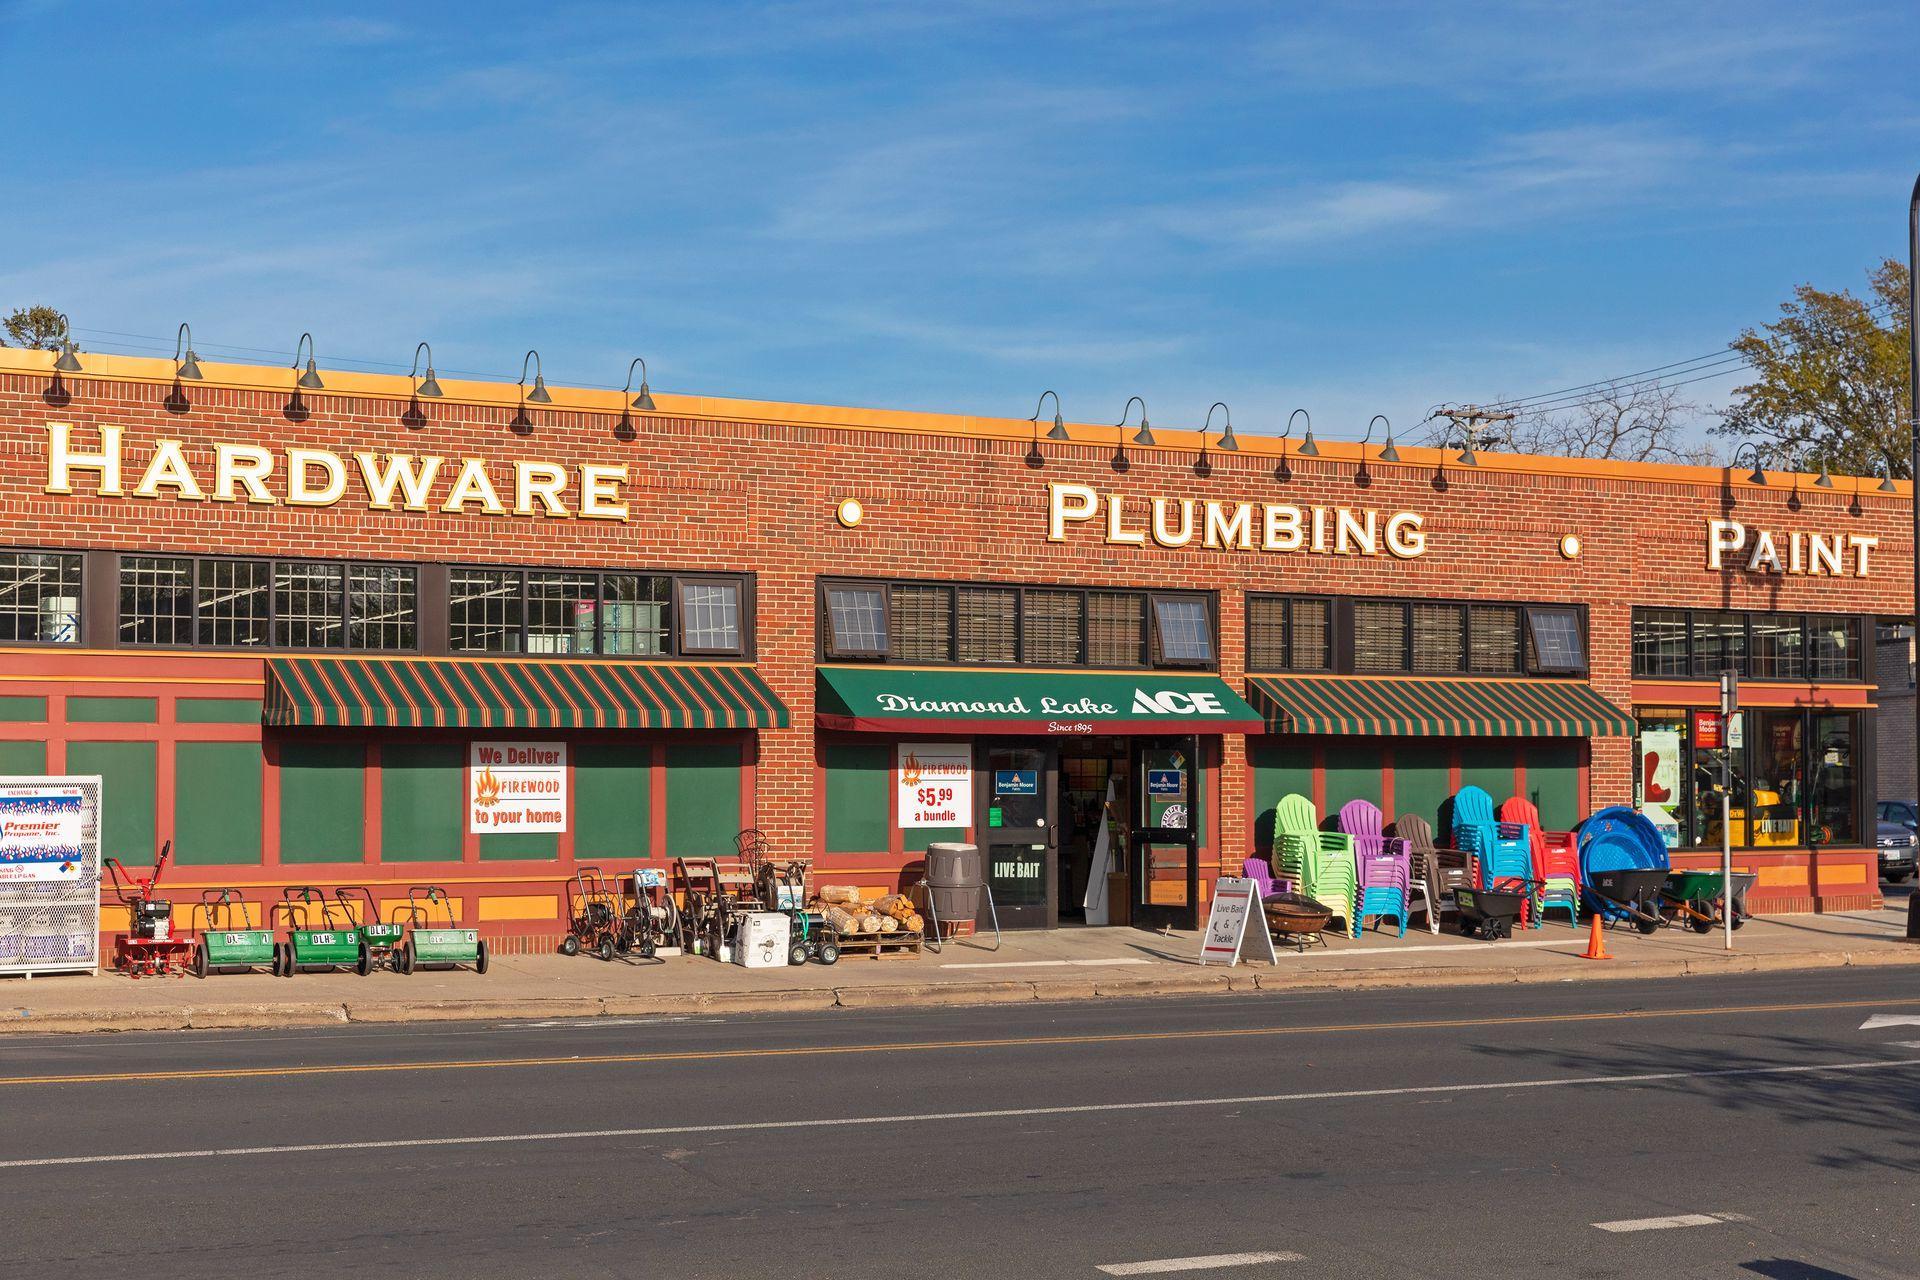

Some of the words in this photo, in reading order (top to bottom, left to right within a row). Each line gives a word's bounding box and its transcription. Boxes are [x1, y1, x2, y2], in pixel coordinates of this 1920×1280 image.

[45, 422, 630, 522] HARDWARE
[1046, 482, 1427, 559] PLUMBING
[1705, 516, 1879, 578] PAINT
[876, 693, 1031, 714] Diamond
[1041, 697, 1118, 715] Lake
[1131, 688, 1228, 715] ACE
[1048, 721, 1072, 733] Since
[1074, 723, 1093, 734] 1895
[478, 747, 503, 764] We
[507, 747, 560, 764] Deliver
[922, 763, 968, 775] FIREWOOD
[501, 780, 560, 793] FIREWOOD
[917, 788, 953, 807] $5.99
[475, 809, 489, 824] to
[492, 812, 523, 827] your
[526, 808, 562, 823] home
[914, 812, 921, 822] a
[923, 810, 956, 821] bundle
[4, 821, 61, 831] Premier
[994, 862, 1015, 878] LIVE
[1016, 862, 1040, 878] BAIT
[1216, 904, 1230, 913] Live
[1230, 905, 1244, 913] Bait
[1223, 919, 1230, 929] &
[370, 926, 386, 936] DLH
[467, 932, 473, 941] 4
[313, 934, 330, 944] DLH
[348, 934, 354, 943] 5
[1213, 934, 1234, 944] Tackle
